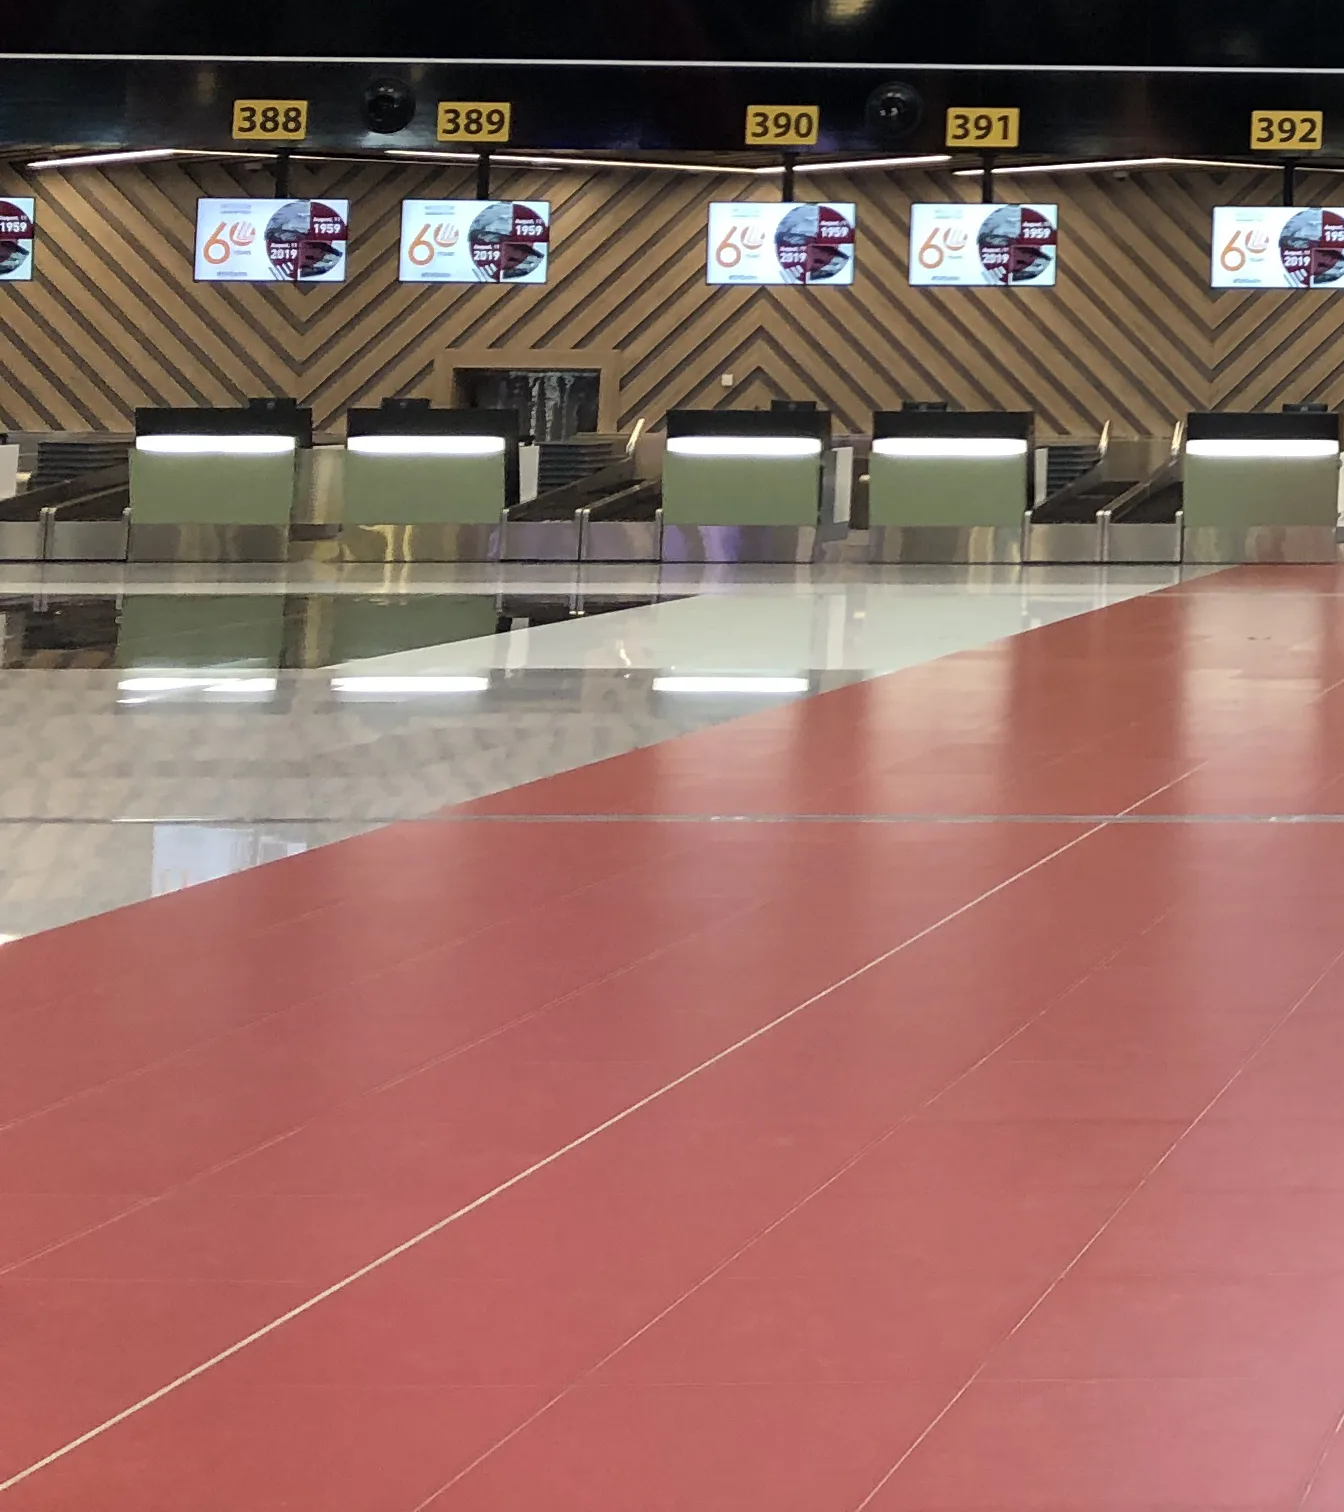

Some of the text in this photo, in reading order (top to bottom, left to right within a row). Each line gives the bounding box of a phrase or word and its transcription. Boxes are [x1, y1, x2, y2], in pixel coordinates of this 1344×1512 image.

[237, 107, 302, 133] 388
[442, 109, 505, 136] 389
[750, 111, 814, 139] 390
[950, 114, 1011, 140] 391
[1255, 117, 1318, 143] 392
[313, 223, 341, 234] 1959
[270, 248, 298, 259] 2019
